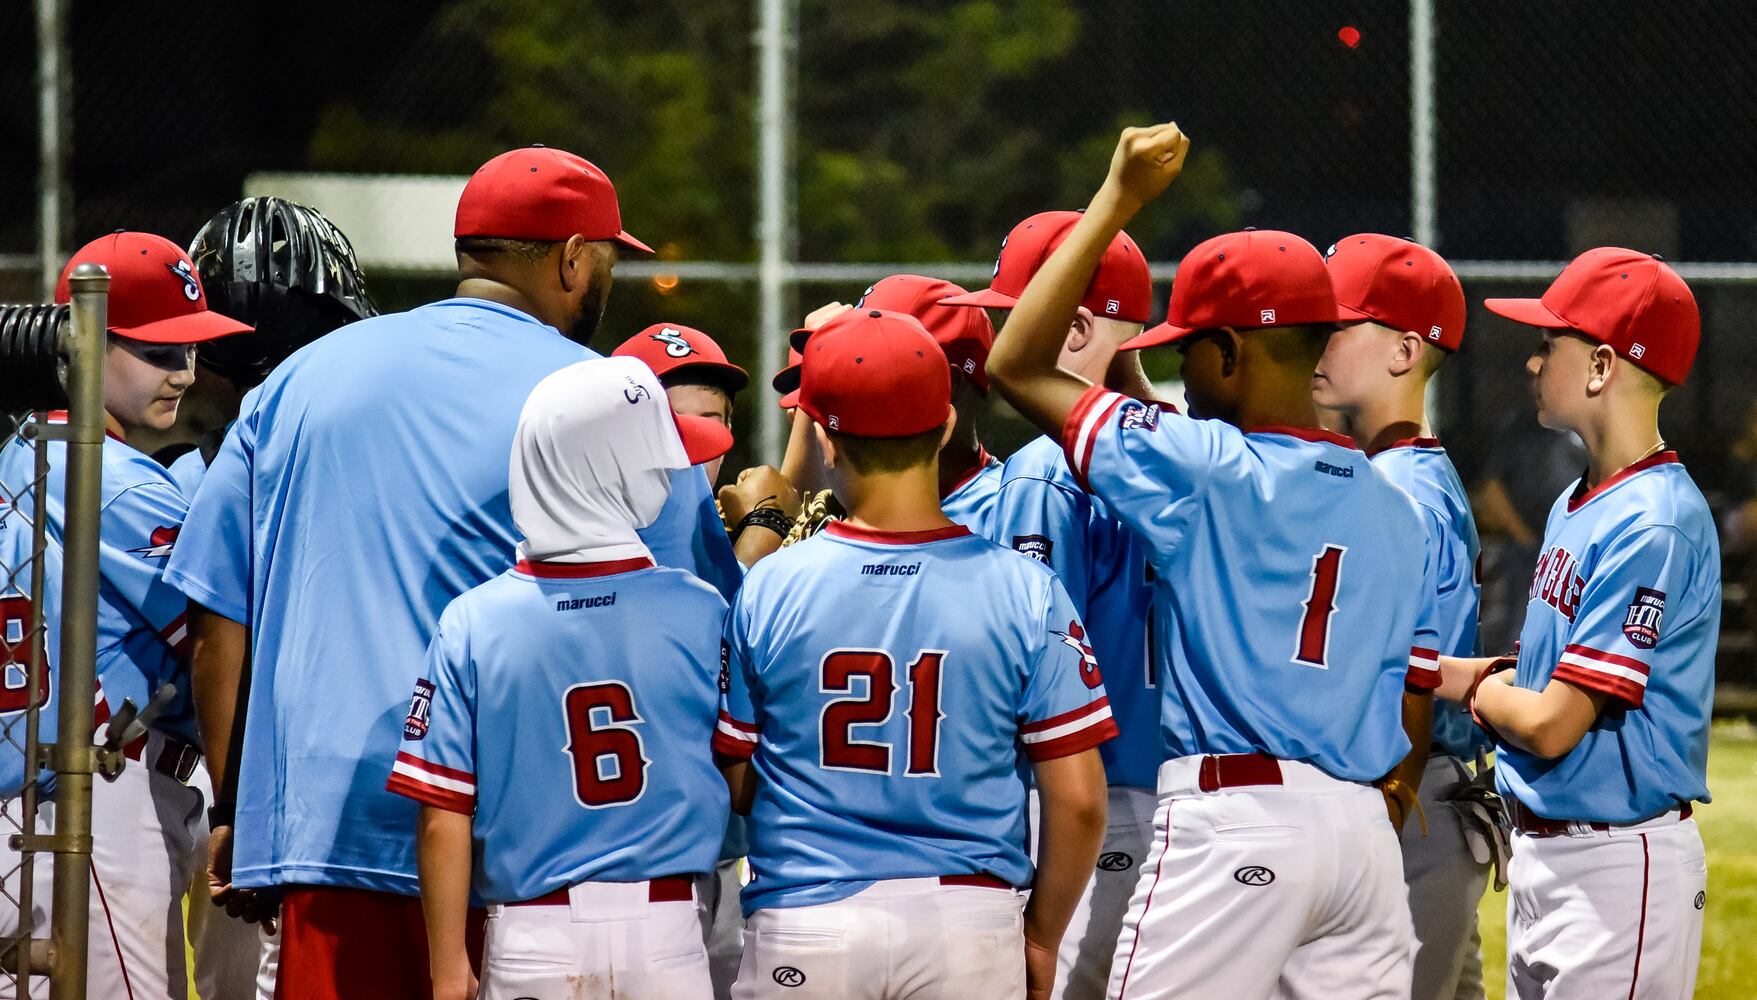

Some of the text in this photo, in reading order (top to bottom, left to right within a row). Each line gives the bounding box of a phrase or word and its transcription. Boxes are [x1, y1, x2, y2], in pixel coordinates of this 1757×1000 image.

[557, 592, 617, 611] marucci
[861, 562, 922, 576] marucci
[1289, 543, 1349, 670] 1
[1631, 632, 1653, 645] CLUB
[561, 679, 654, 810] 6
[819, 647, 950, 778] 21
